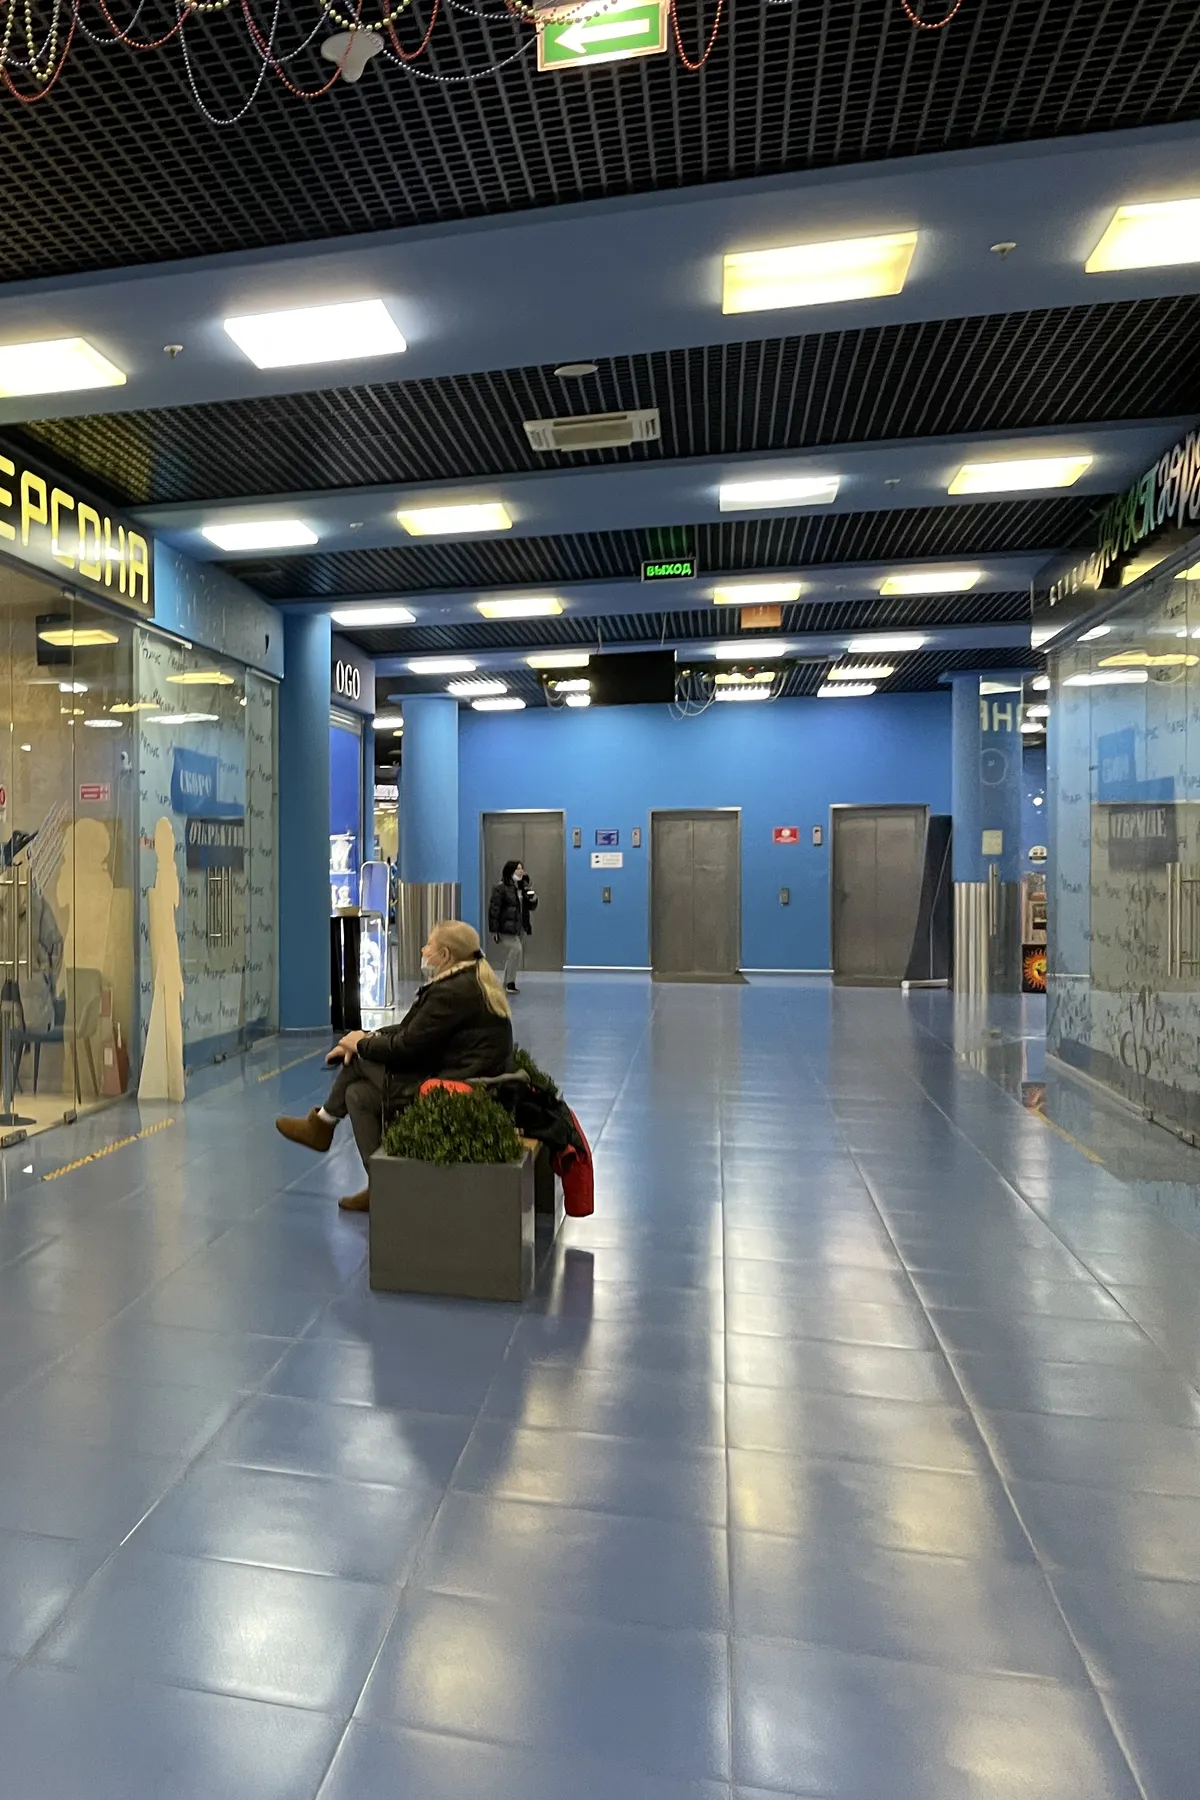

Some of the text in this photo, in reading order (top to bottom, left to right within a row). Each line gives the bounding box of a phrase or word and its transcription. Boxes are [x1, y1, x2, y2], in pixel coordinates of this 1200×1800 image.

[646, 562, 692, 577] ВЫХОД
[336, 659, 360, 700] OGO
[180, 769, 212, 797] СКОРО
